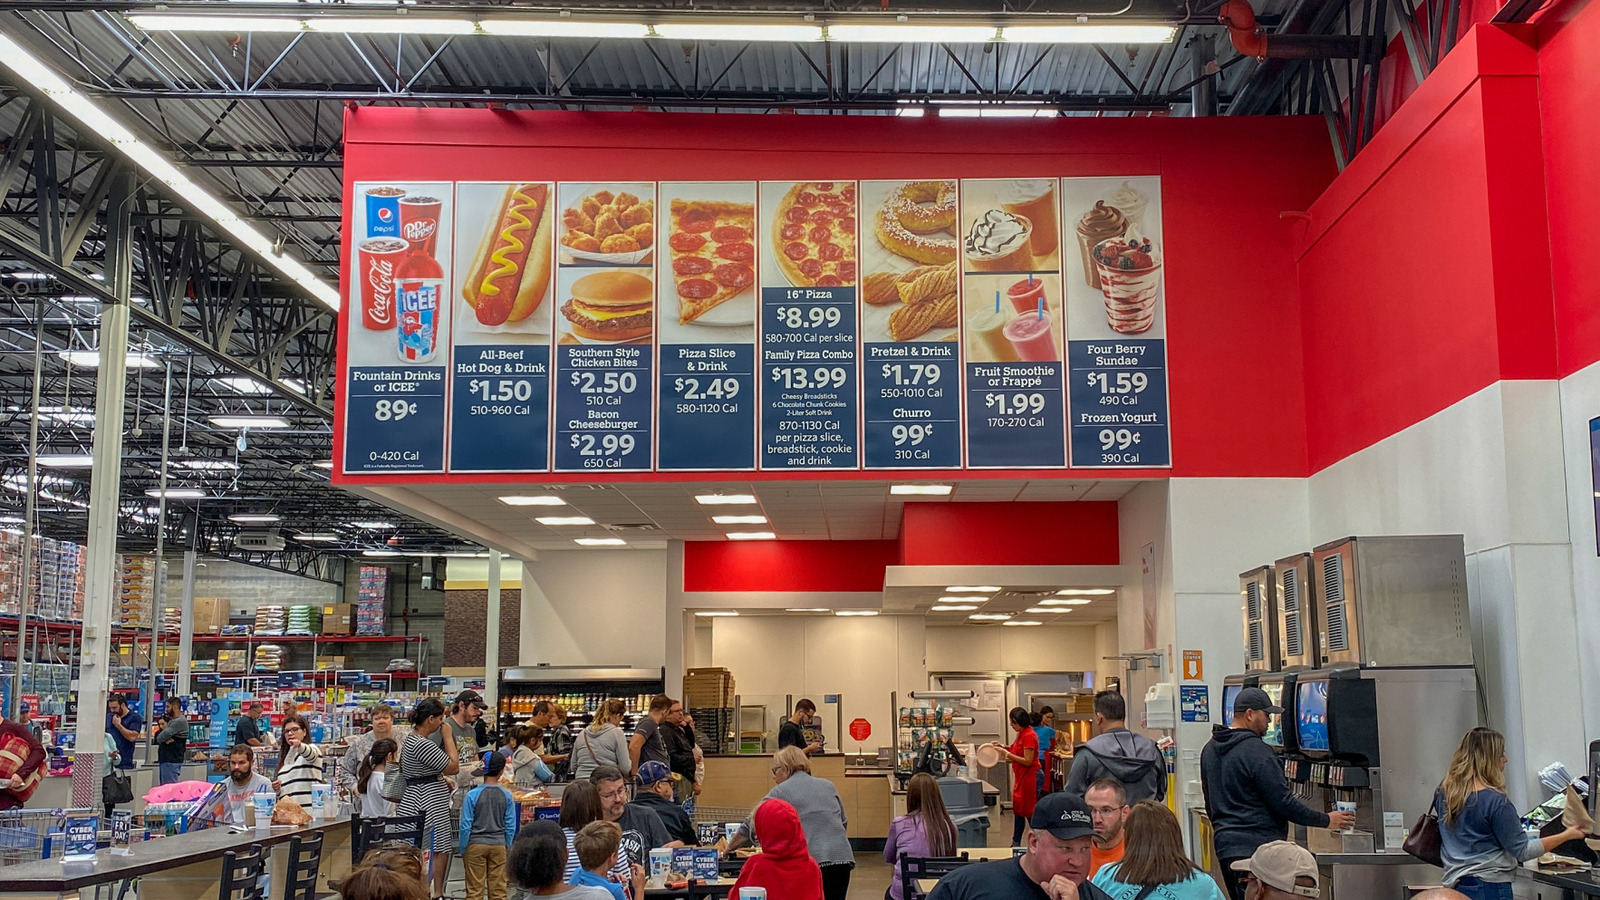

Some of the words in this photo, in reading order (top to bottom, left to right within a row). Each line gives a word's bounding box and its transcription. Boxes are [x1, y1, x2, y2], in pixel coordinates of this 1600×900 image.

[374, 225, 395, 233] pepsi
[415, 221, 428, 229] Dr
[404, 222, 435, 239] Pepper
[787, 290, 803, 299] 16"
[806, 290, 832, 298] Pizza
[402, 289, 436, 312] ICEE
[777, 306, 840, 328] $8.99
[766, 333, 802, 343] 580-700
[804, 333, 817, 342] Cal
[819, 335, 833, 344] per
[835, 333, 853, 342] slice
[480, 350, 524, 359] All-Beef
[569, 348, 613, 357] Southern
[615, 348, 640, 359] Style
[679, 349, 706, 358] Pizza
[709, 348, 736, 358] Slice
[871, 347, 908, 356] Pretzel
[911, 347, 919, 356] &
[922, 346, 951, 355] Drink
[1088, 345, 1112, 354] Four
[1115, 345, 1146, 355] Berry
[765, 350, 795, 361] Family
[797, 350, 820, 359] Pizza
[822, 350, 853, 358] Combo
[1096, 356, 1138, 365] Sundae
[571, 358, 611, 367] Chicken
[613, 358, 637, 366] Bites
[687, 362, 695, 371] &
[698, 361, 727, 370] Drink
[457, 364, 476, 372] Hot
[479, 363, 501, 374] Dog
[504, 363, 512, 372] &
[515, 363, 545, 372] Drink
[975, 367, 1000, 376] Fruit
[1003, 366, 1054, 376] Smoothie
[353, 371, 401, 380] Fountain
[405, 371, 441, 380] Drinks
[772, 367, 846, 389] $13.99
[882, 363, 940, 385] $1.79
[389, 382, 420, 391] ICEE®
[571, 371, 636, 393] $2.50
[1003, 376, 1041, 387] Frappé
[1088, 372, 1147, 393] $1.59
[470, 379, 531, 401] $1.50
[675, 377, 739, 399] $2.49
[881, 388, 924, 397] 550-1010
[927, 388, 942, 397] Cal
[587, 396, 603, 405] 510
[606, 396, 621, 405] Cal
[986, 393, 1044, 414] $1.99
[1099, 396, 1119, 405] 490
[1122, 396, 1137, 405] Cal
[375, 400, 417, 421] 89¢
[471, 406, 511, 415] 510-960
[514, 405, 529, 414] Cal
[677, 404, 720, 413] 580-1120
[723, 403, 737, 412] Cal
[893, 408, 931, 417] Churro
[588, 410, 619, 418] Bacon
[1081, 414, 1119, 422] Frozen
[1121, 413, 1158, 425] Yogurt
[569, 420, 639, 431] Cheeseburger
[779, 421, 822, 430] 870-1130
[825, 421, 839, 429] Cal
[988, 418, 1026, 427] 170-270
[1029, 417, 1044, 426] Cal
[776, 435, 791, 443] per
[794, 433, 817, 443] pizza
[820, 432, 843, 442] slice,
[892, 424, 932, 446] 99¢
[1099, 429, 1140, 450] 99¢
[571, 433, 635, 455] $2.99
[768, 444, 818, 454] breadstick,
[821, 444, 852, 453] cookie
[370, 452, 401, 460] 0-420
[403, 451, 419, 460] Cal
[895, 450, 912, 459] 310
[915, 450, 929, 459] Cal
[1102, 454, 1121, 463] 390
[1123, 453, 1139, 462] Cal
[584, 459, 603, 467] 650
[606, 458, 621, 467] Cal
[788, 456, 805, 465] and
[808, 456, 831, 464] drink
[115, 822, 128, 830] FRI
[115, 831, 127, 840] DAY
[621, 838, 641, 853] CASH
